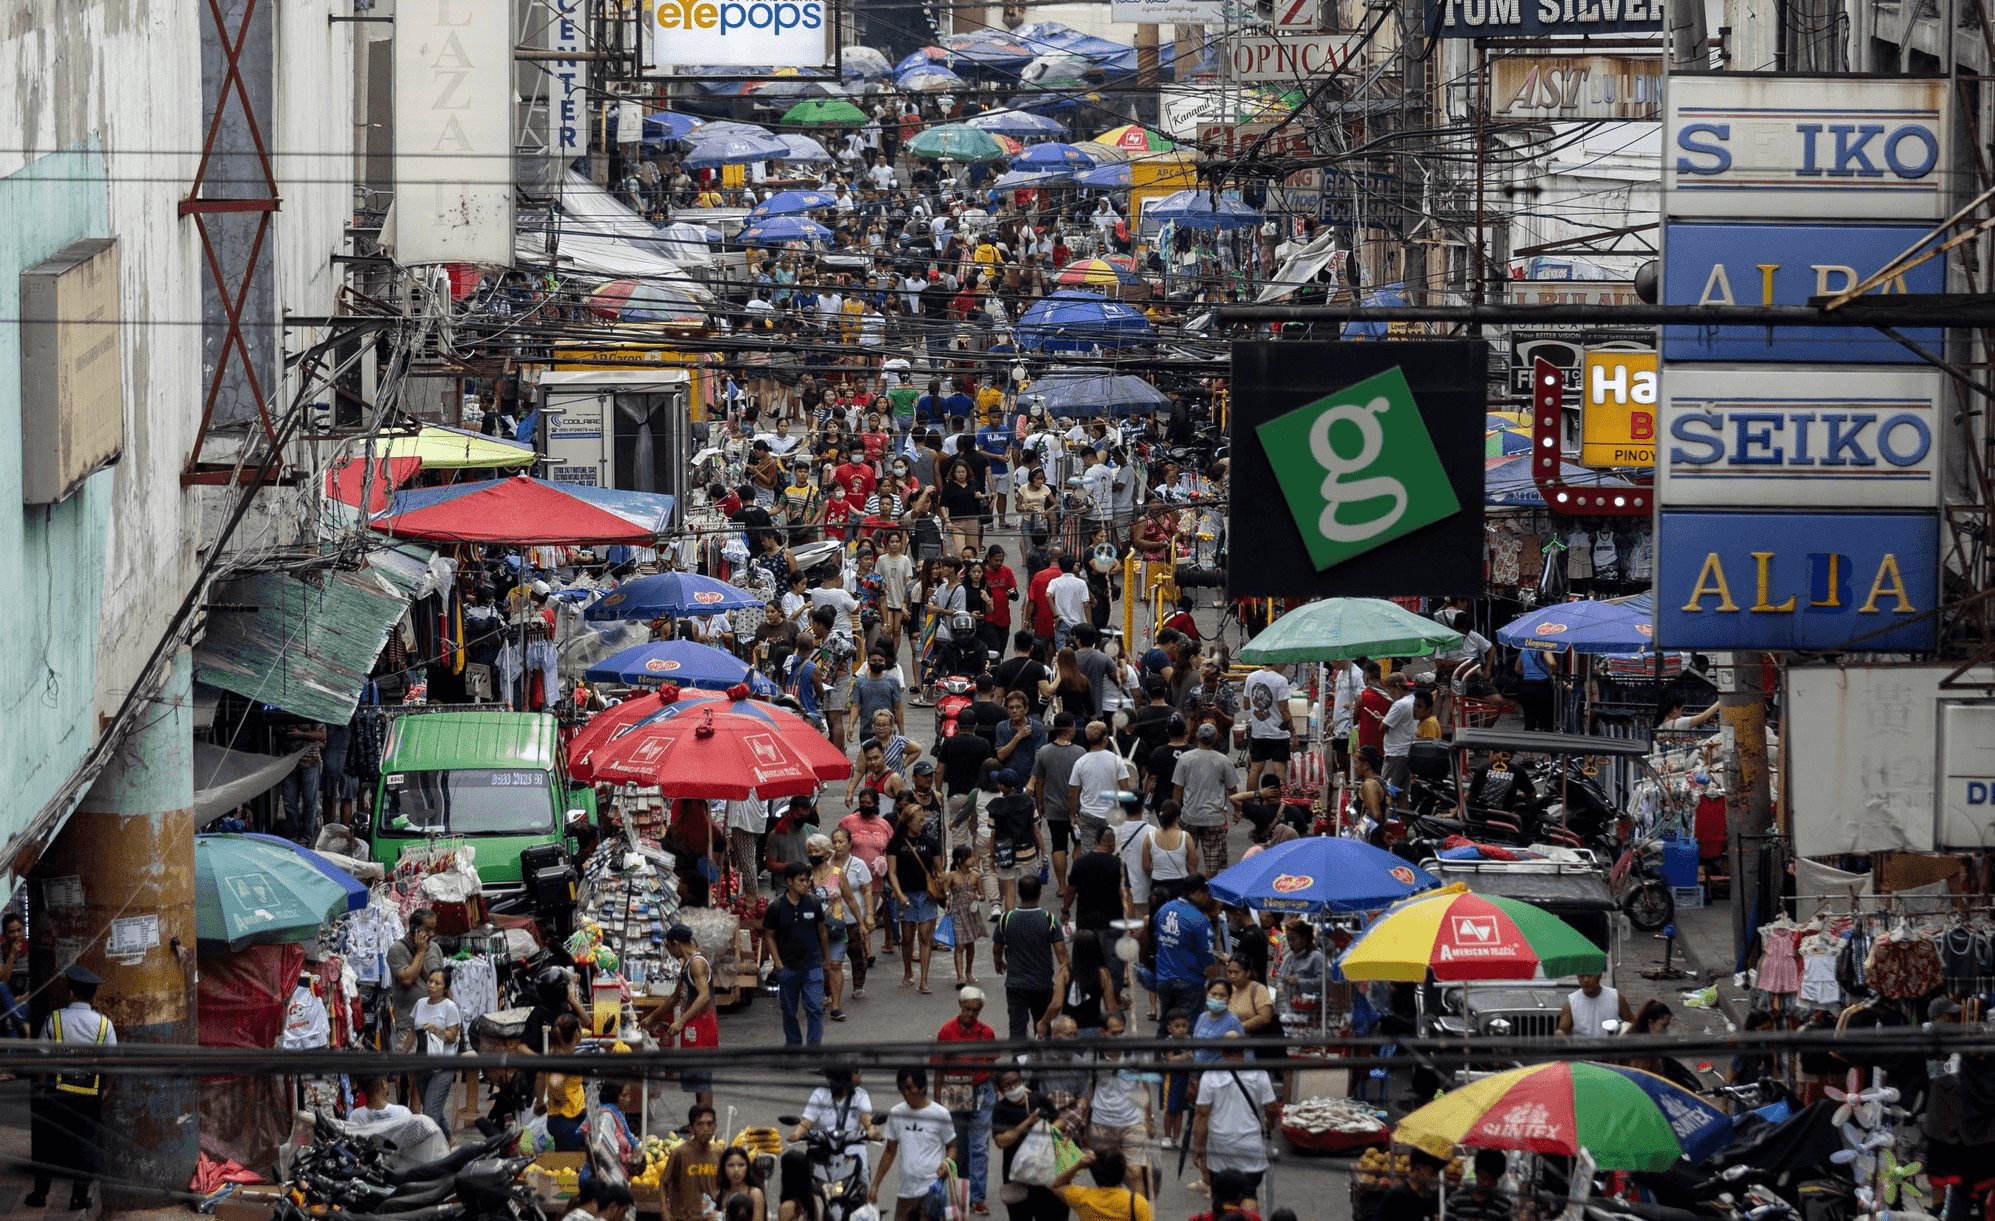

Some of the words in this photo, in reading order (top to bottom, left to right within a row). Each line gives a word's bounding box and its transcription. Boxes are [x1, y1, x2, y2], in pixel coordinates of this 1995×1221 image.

[1234, 43, 1359, 74] OPTICAL
[1496, 65, 1591, 114] AST
[1669, 412, 1931, 467] SEIKO
[1309, 396, 1408, 543] g
